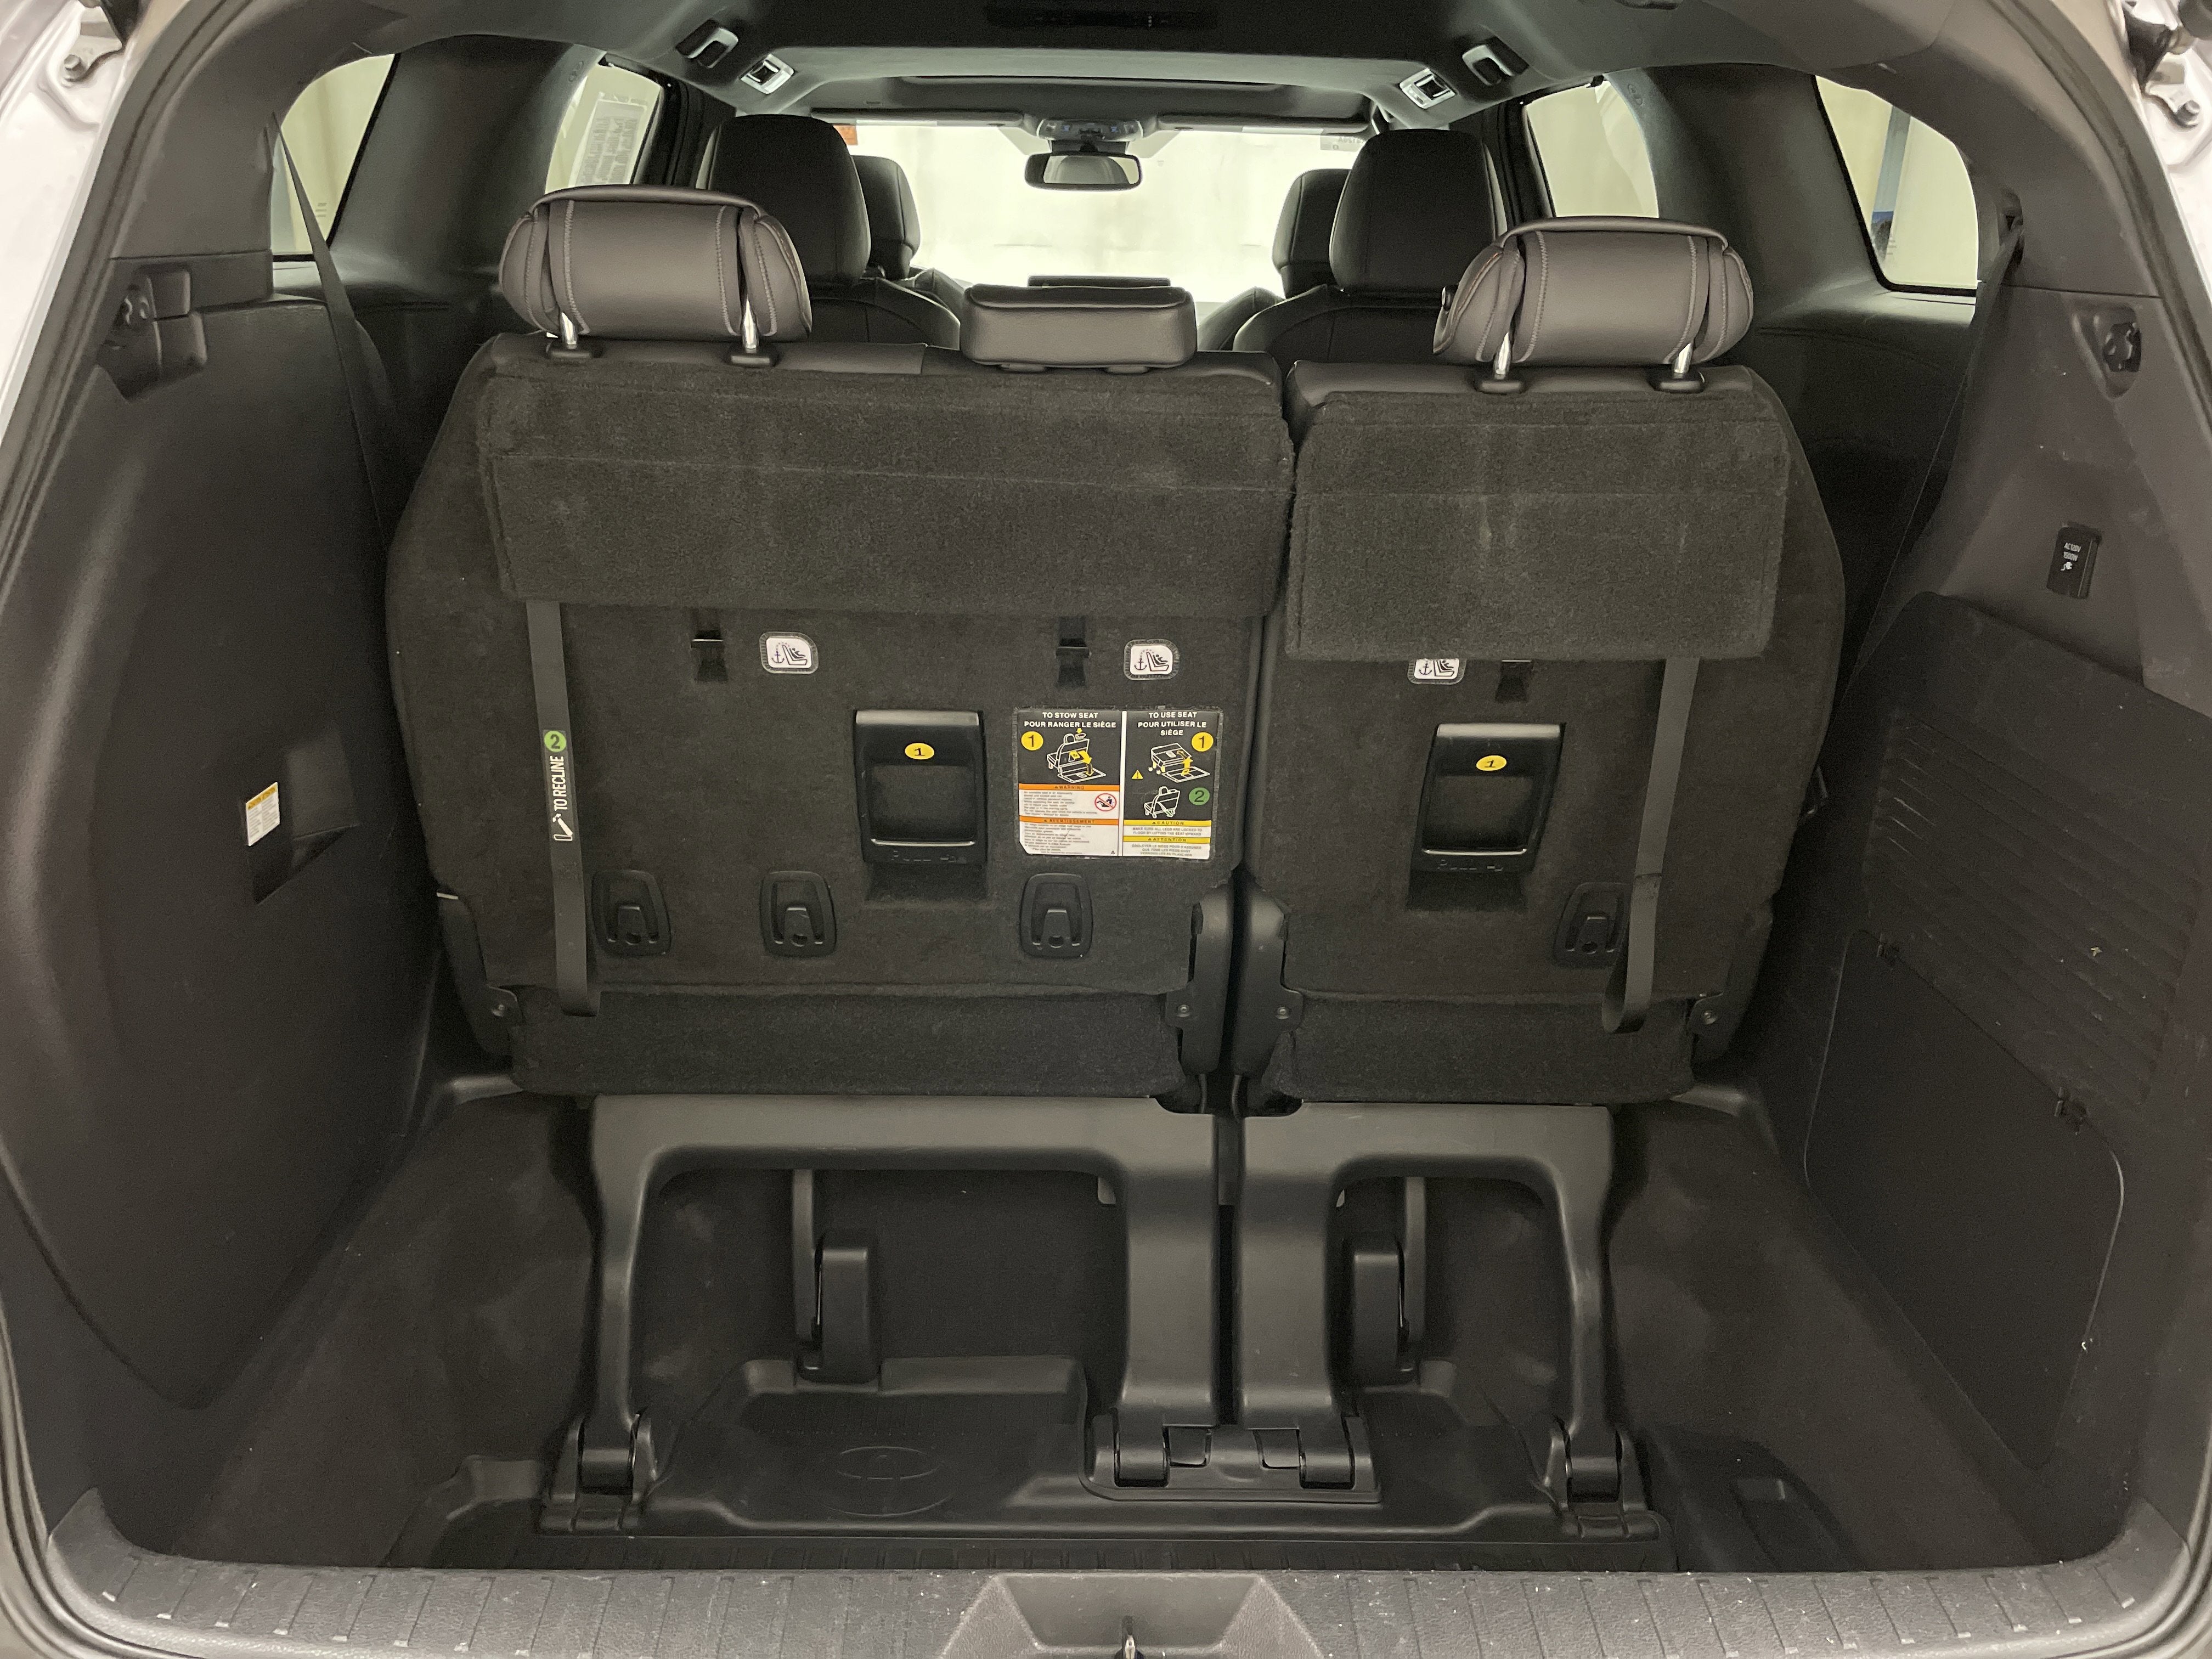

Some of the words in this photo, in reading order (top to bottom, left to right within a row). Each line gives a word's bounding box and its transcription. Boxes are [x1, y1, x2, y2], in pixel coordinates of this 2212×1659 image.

[550, 733, 561, 749] 2
[1028, 735, 1034, 748] 1
[1198, 736, 1205, 748] 1
[915, 748, 926, 756] 1
[550, 755, 567, 797] RECLINE
[1194, 790, 1204, 802] 2
[554, 798, 568, 811] TO
